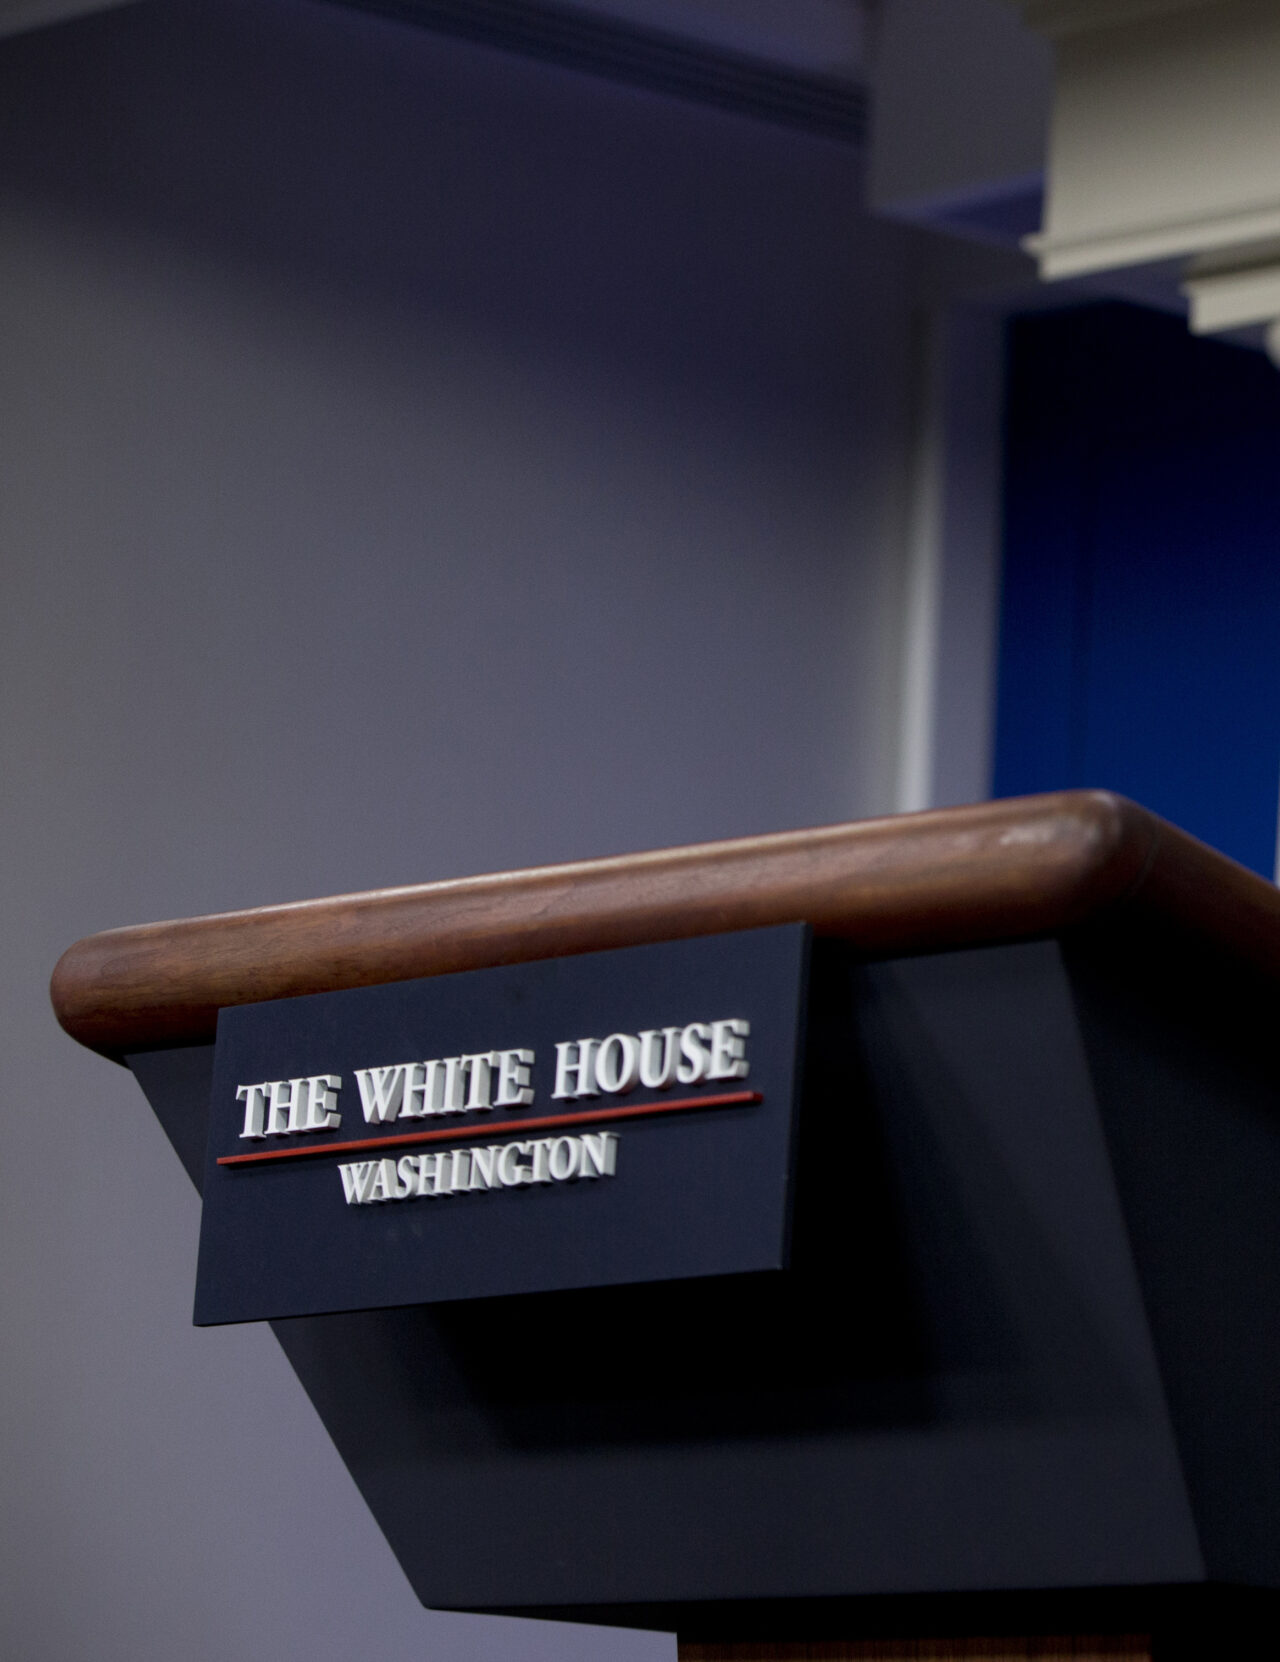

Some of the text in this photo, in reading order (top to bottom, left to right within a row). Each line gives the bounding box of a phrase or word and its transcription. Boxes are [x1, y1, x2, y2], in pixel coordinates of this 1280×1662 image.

[236, 1019, 750, 1138] THE WHITE HOUSE
[338, 1132, 619, 1205] WASHINGTON
